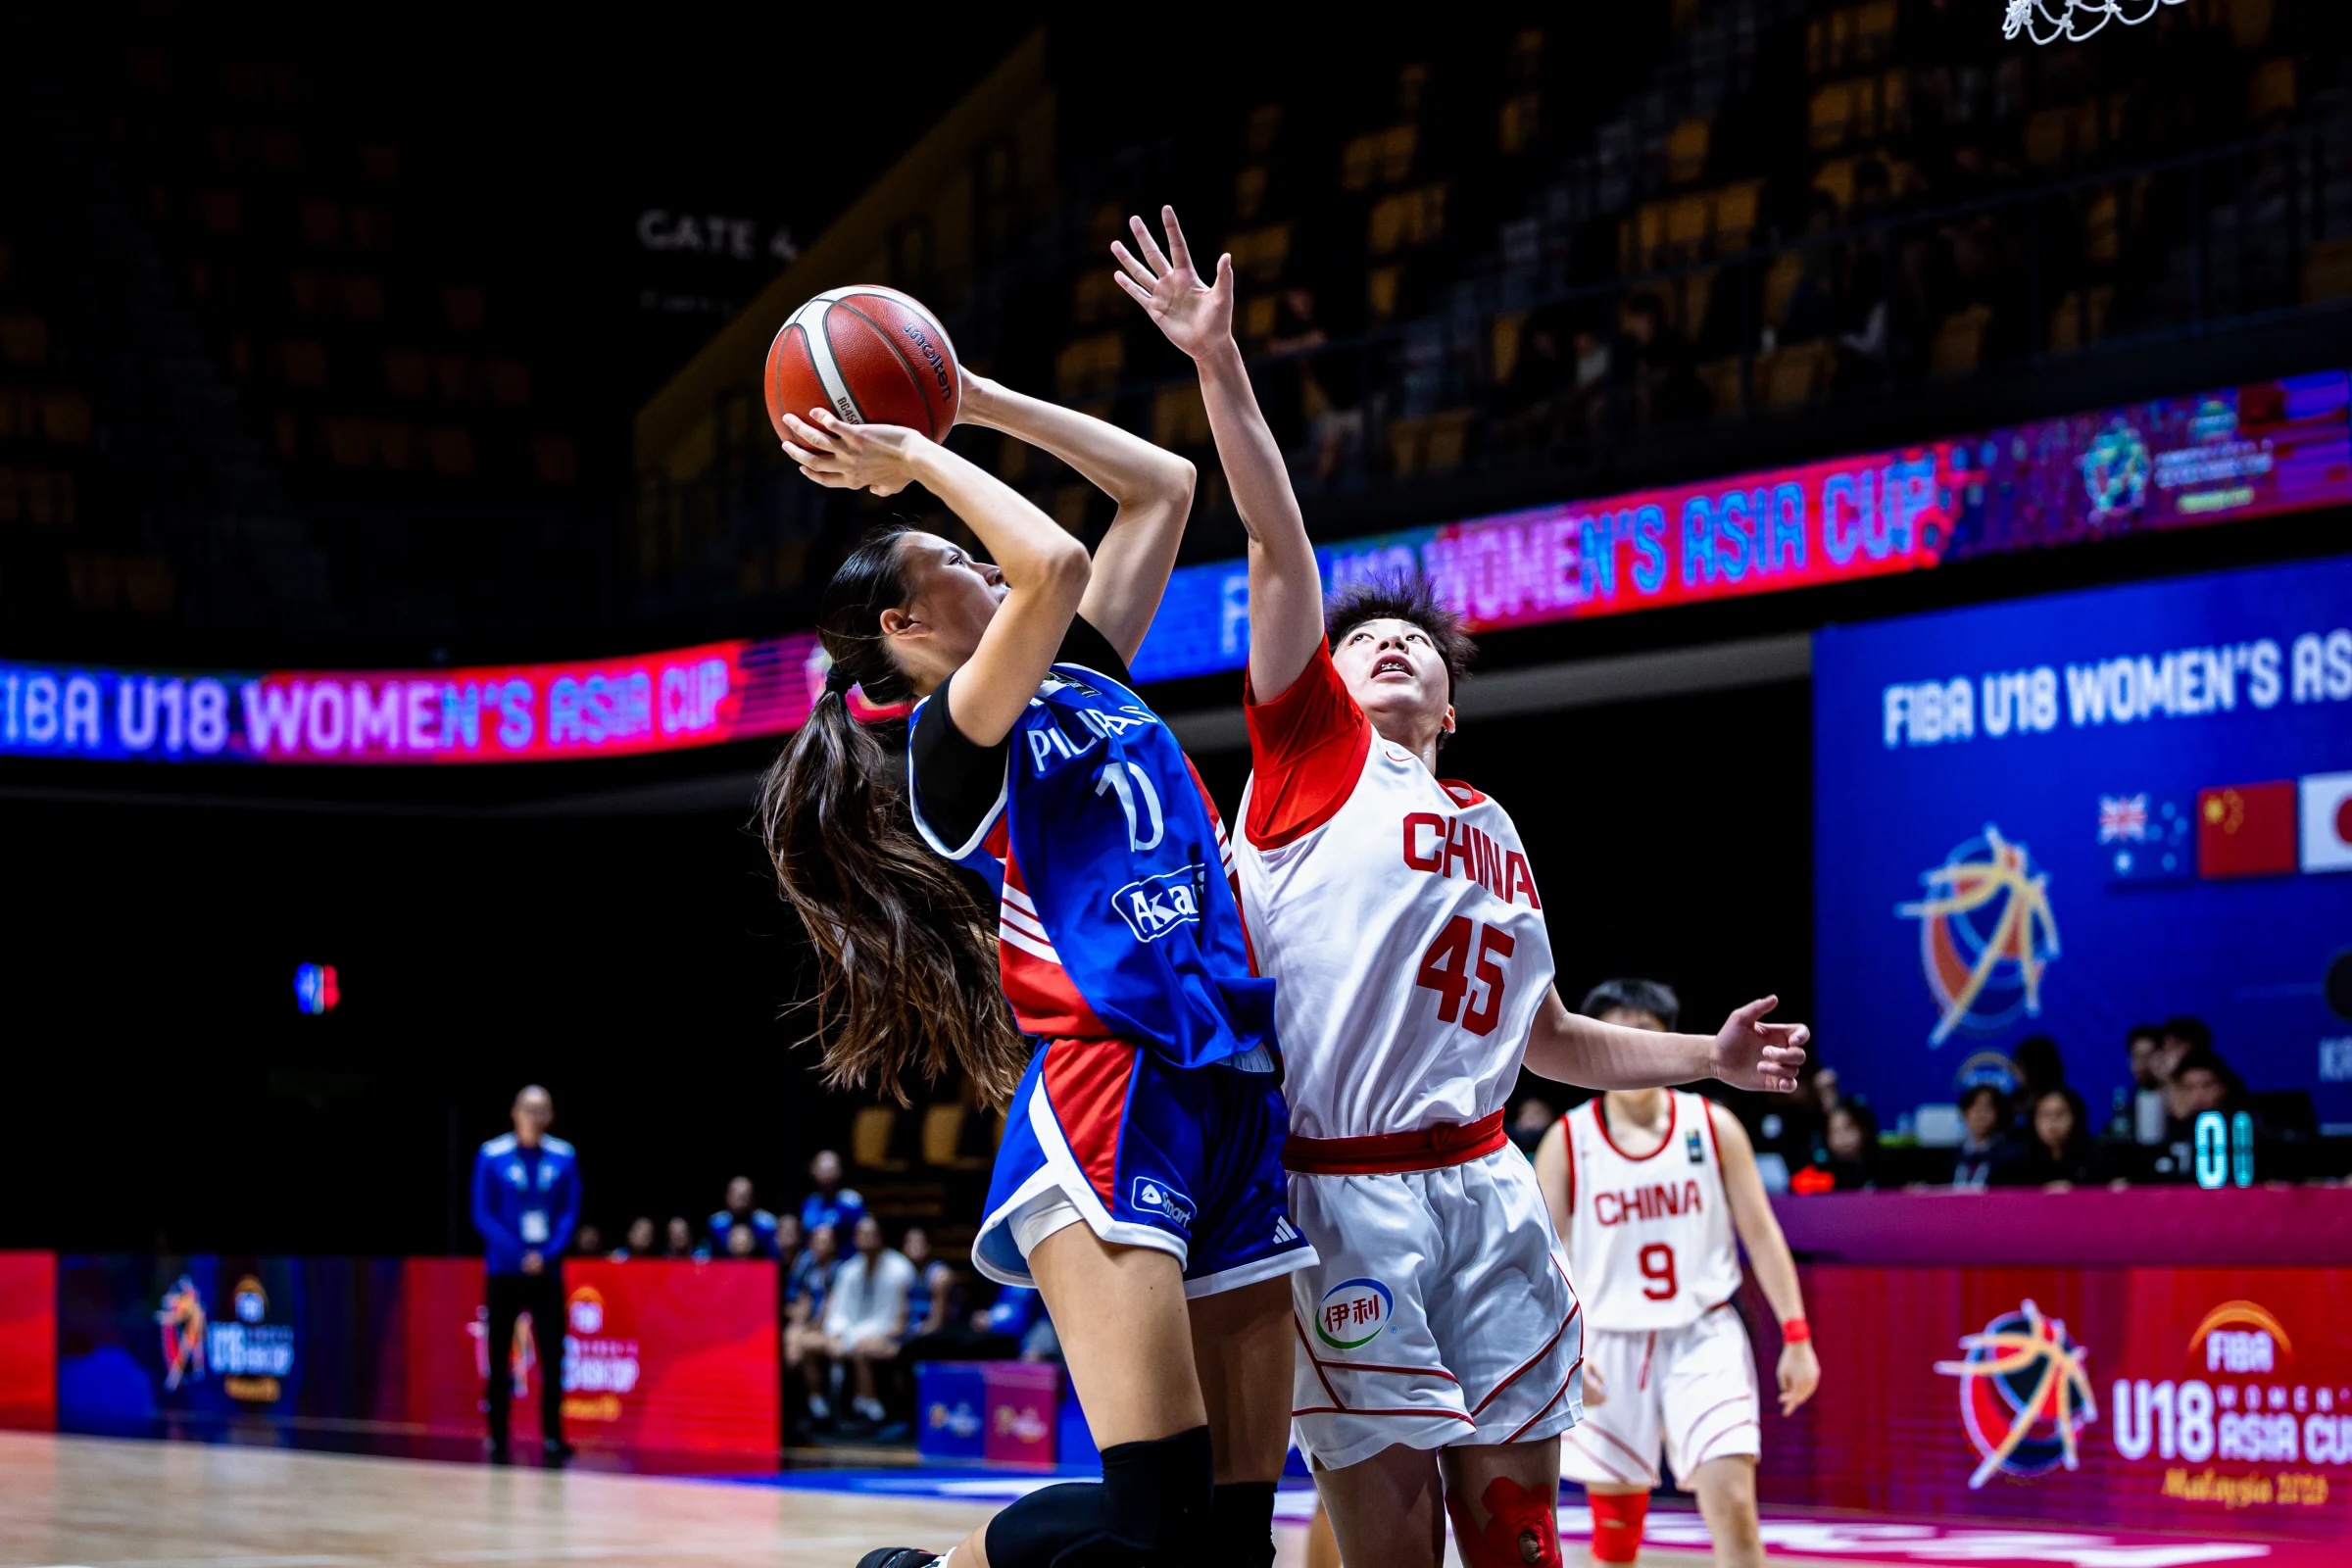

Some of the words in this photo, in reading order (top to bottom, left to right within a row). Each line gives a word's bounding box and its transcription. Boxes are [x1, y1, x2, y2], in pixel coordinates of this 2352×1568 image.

[636, 208, 758, 261] GATE
[904, 323, 952, 403] molten
[1682, 481, 1806, 583] ASIA
[1823, 457, 1936, 565] CUP
[0, 673, 101, 748] IBA
[119, 676, 229, 753] U18
[238, 679, 535, 753] WOMEN'S
[548, 670, 653, 749] ASIA
[660, 658, 731, 733] CUP
[1883, 676, 1974, 749] FIBA
[1983, 666, 2059, 738] U18
[2065, 638, 2282, 727] WOMEN'S
[1402, 811, 1541, 910] CHINA
[1415, 914, 1515, 1037] 45
[1162, 1191, 1191, 1229] Smart
[1593, 1180, 1703, 1227] CHINA
[1638, 1243, 1679, 1301] 9
[1325, 1294, 1380, 1333] 伊利
[2112, 1378, 2215, 1462] U18
[2218, 1410, 2299, 1461] ASIA
